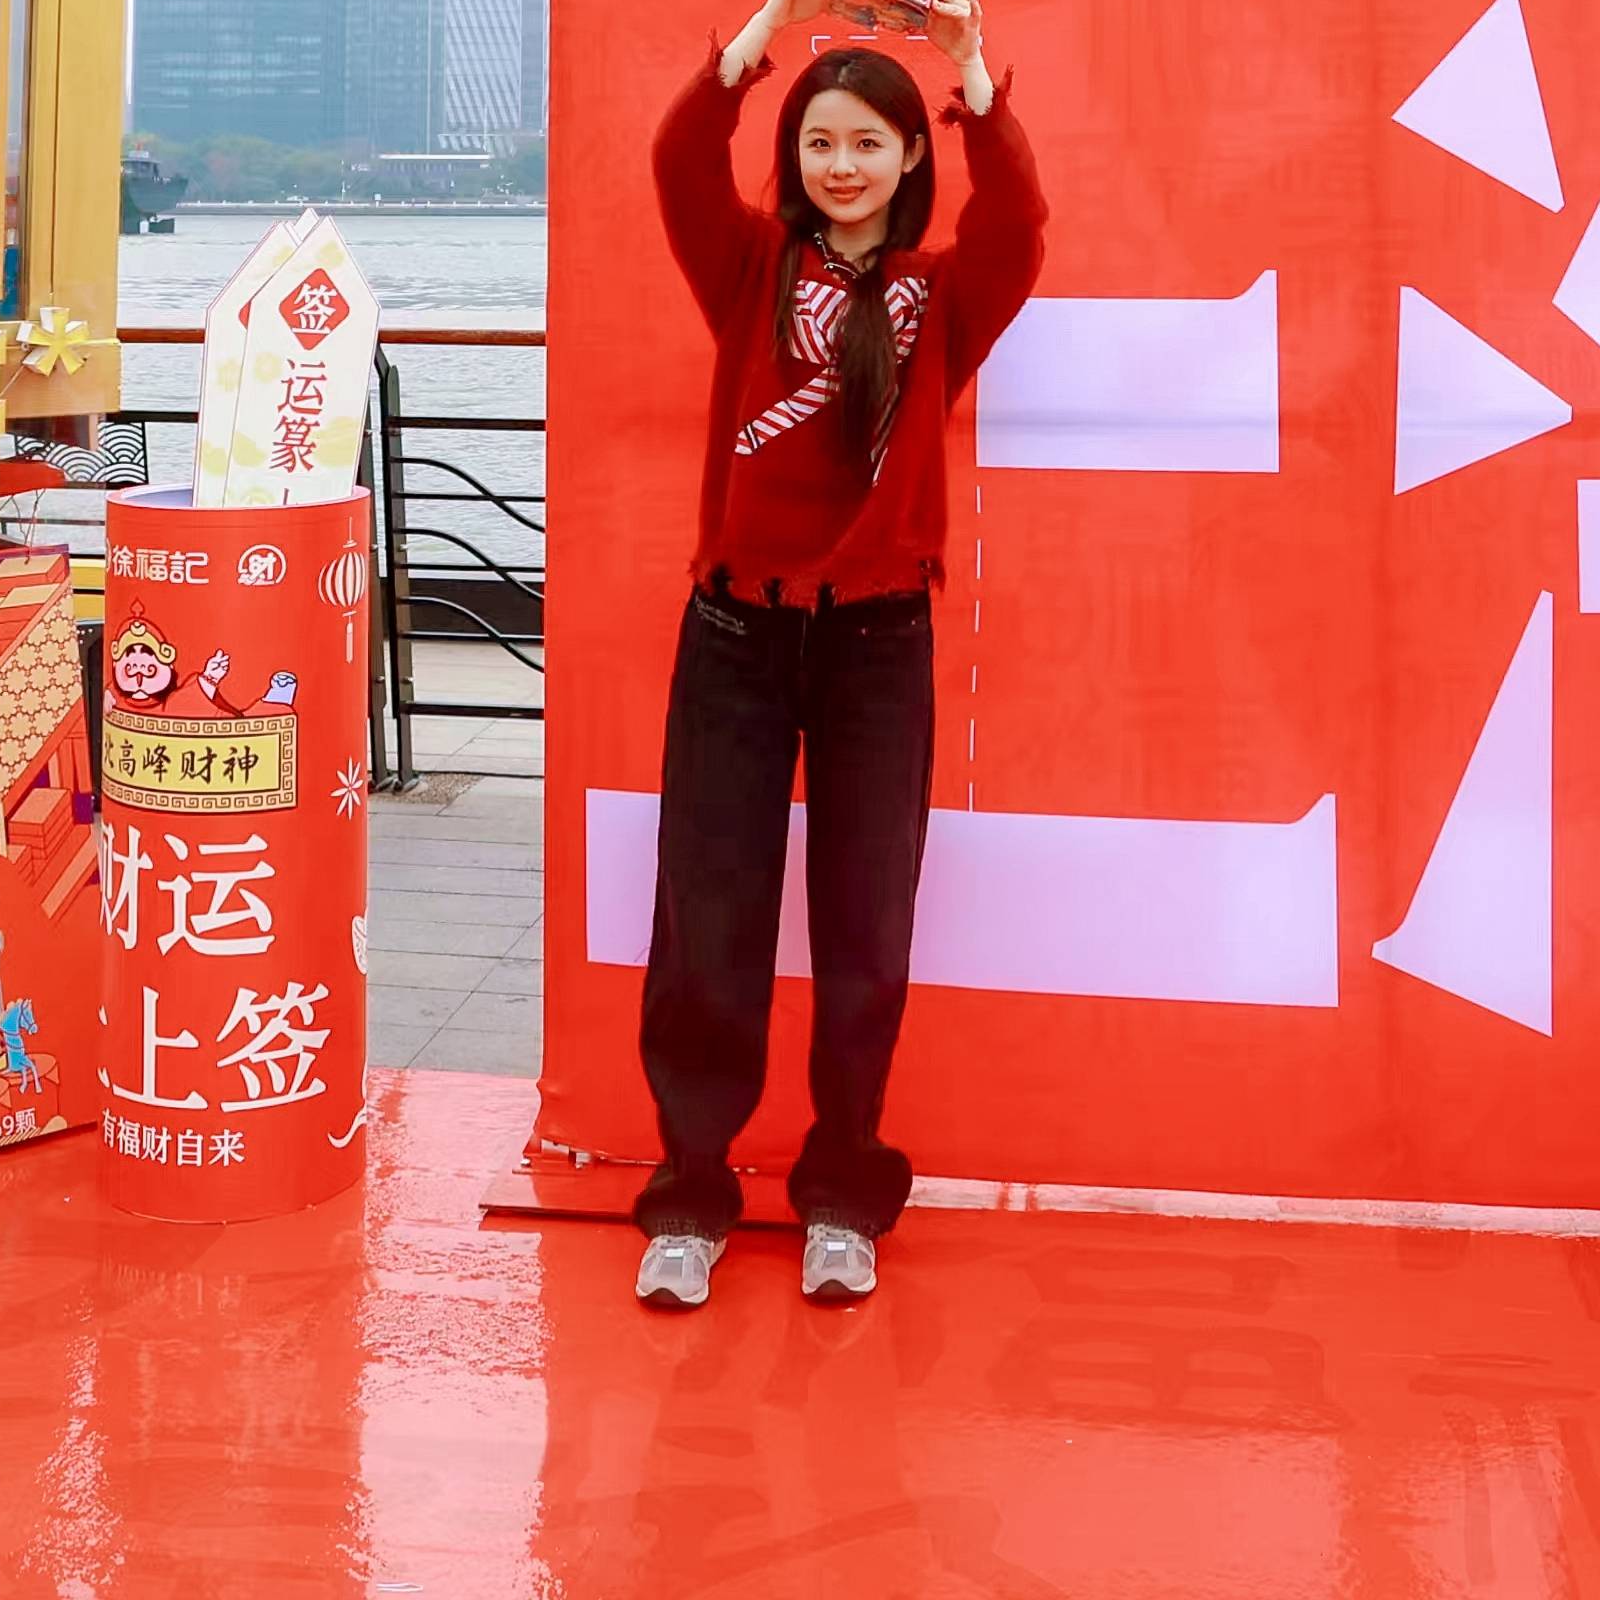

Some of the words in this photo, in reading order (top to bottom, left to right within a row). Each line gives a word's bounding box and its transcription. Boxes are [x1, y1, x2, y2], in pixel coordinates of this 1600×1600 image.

[291, 283, 337, 336] 签
[112, 545, 210, 585] 徐福記
[99, 980, 331, 1114] 上签
